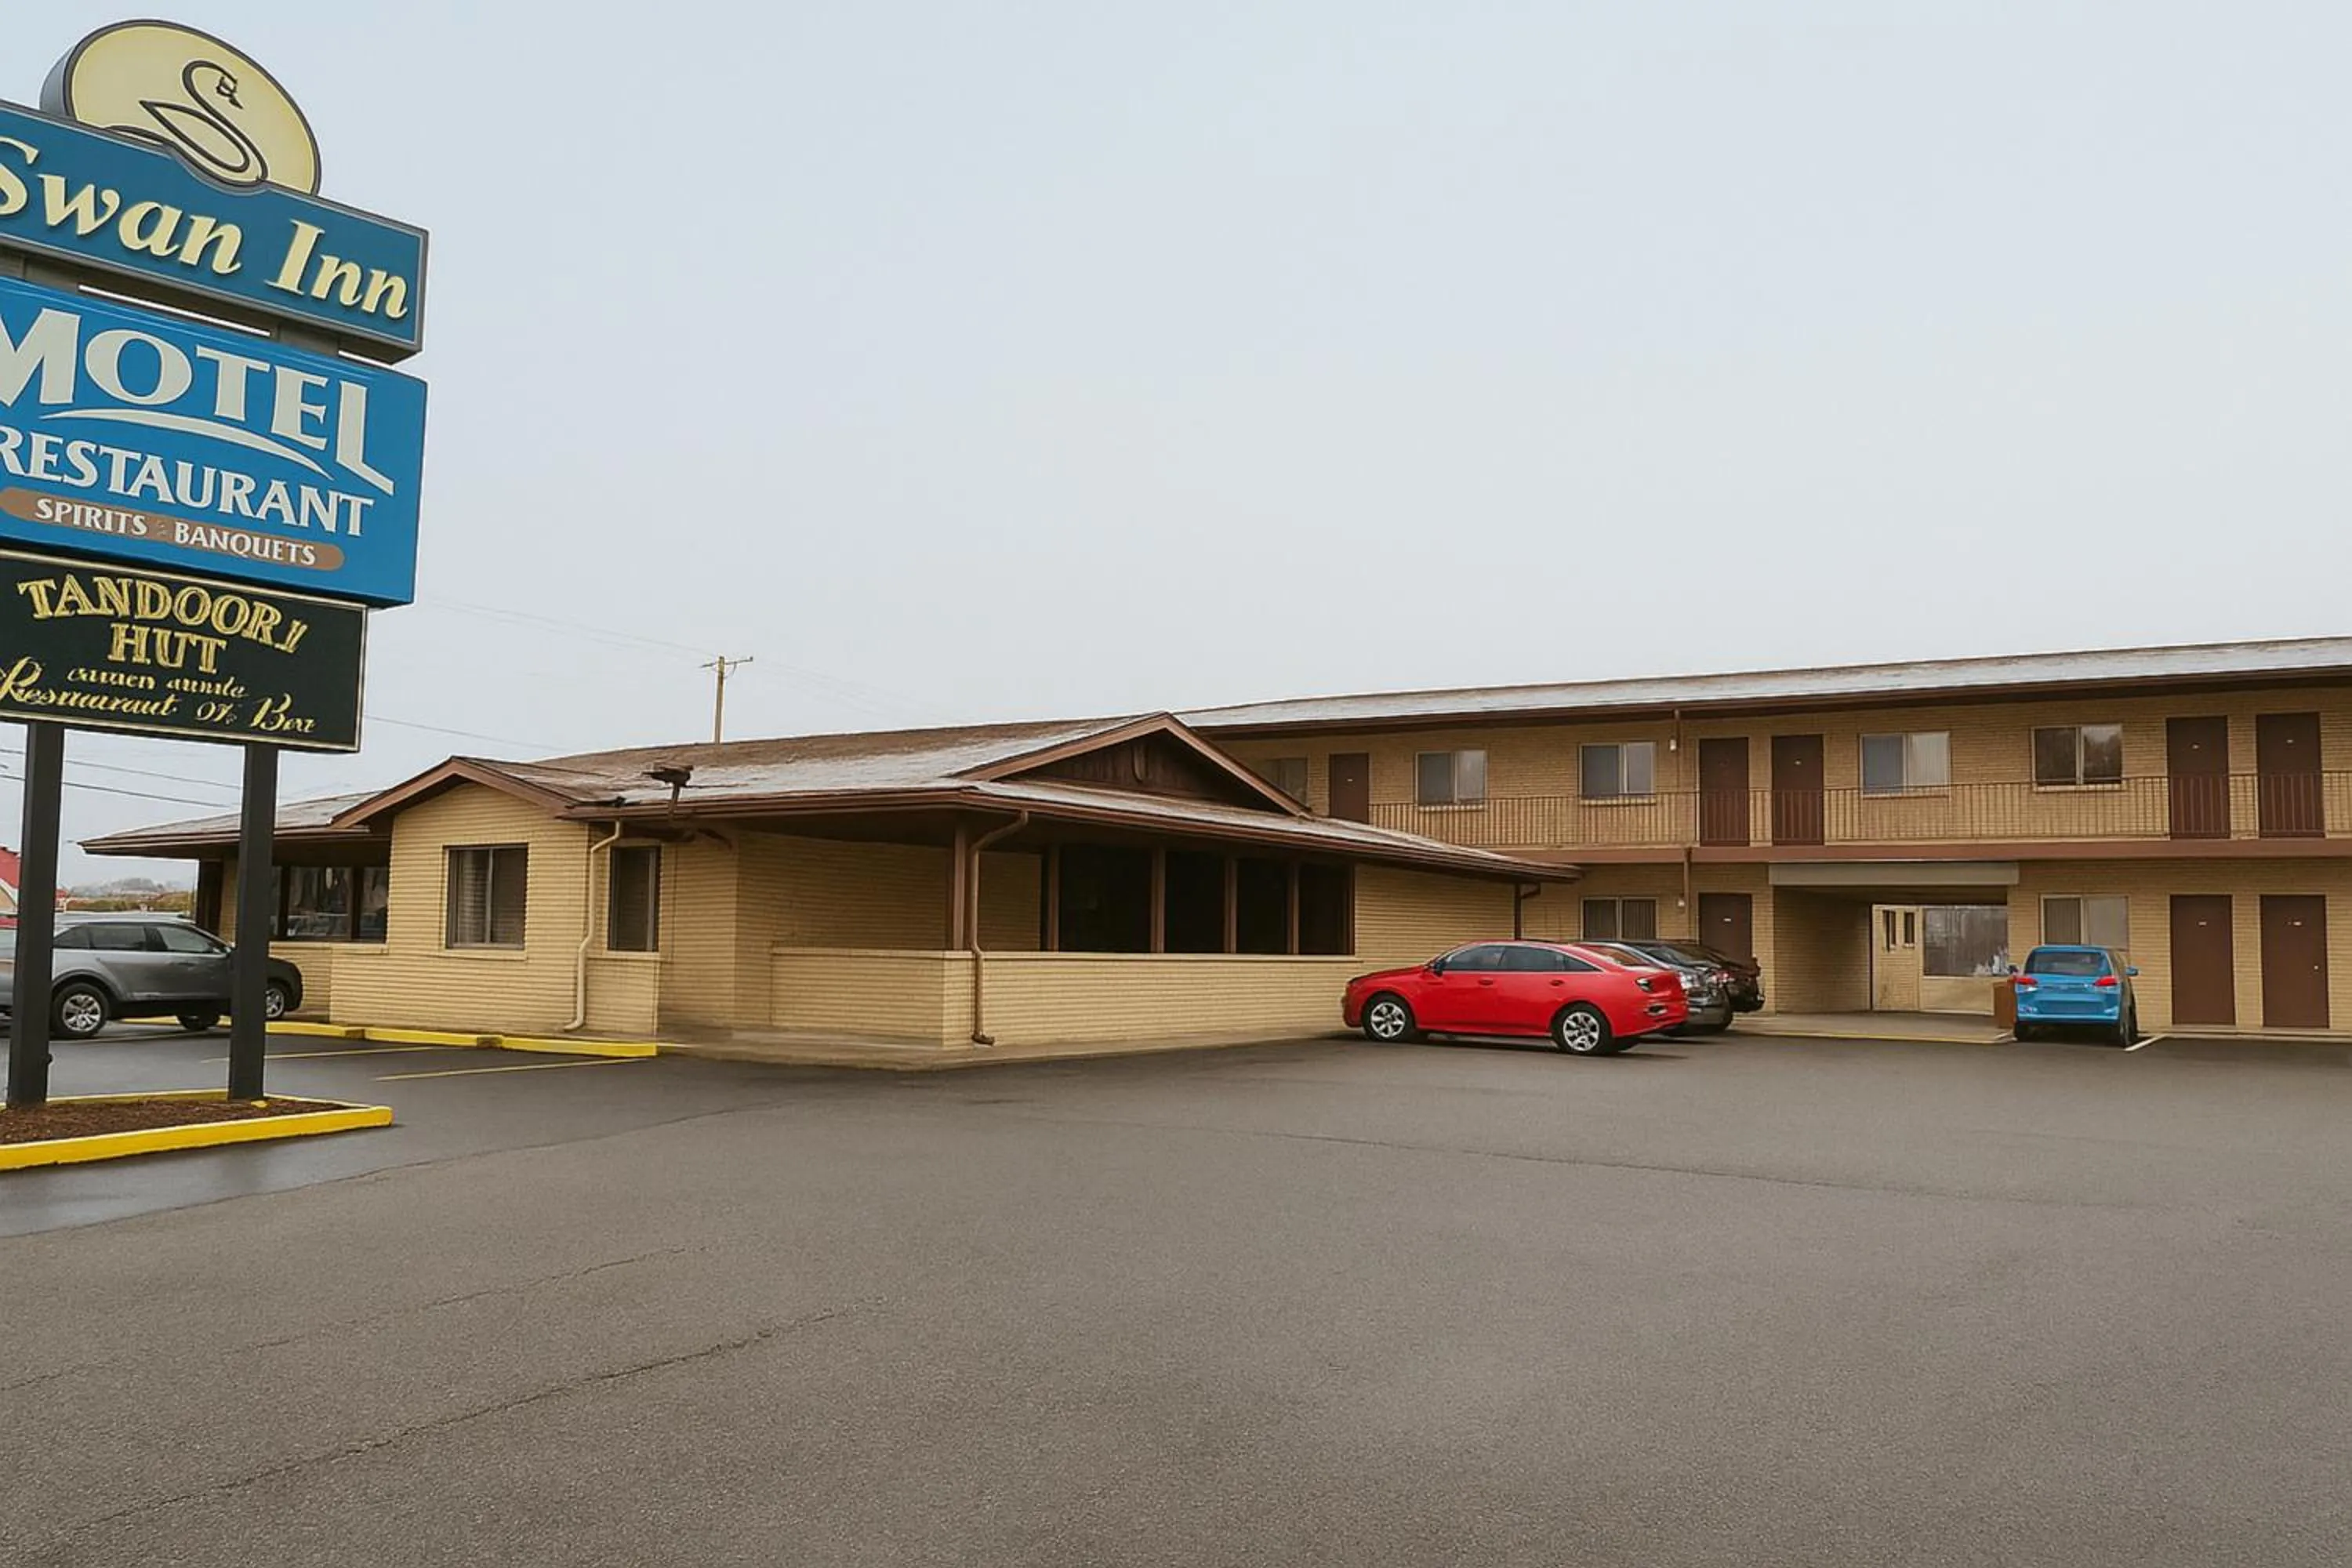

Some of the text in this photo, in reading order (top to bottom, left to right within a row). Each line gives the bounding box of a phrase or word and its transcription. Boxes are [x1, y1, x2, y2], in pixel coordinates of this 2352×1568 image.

[0, 136, 408, 320] Swan Inn
[0, 308, 394, 495] MOTEL
[0, 426, 374, 537] RESTAURANT
[35, 498, 317, 566] SPIRITS BANQUETS
[18, 574, 307, 653] TANDOORI
[107, 622, 227, 673] HUT
